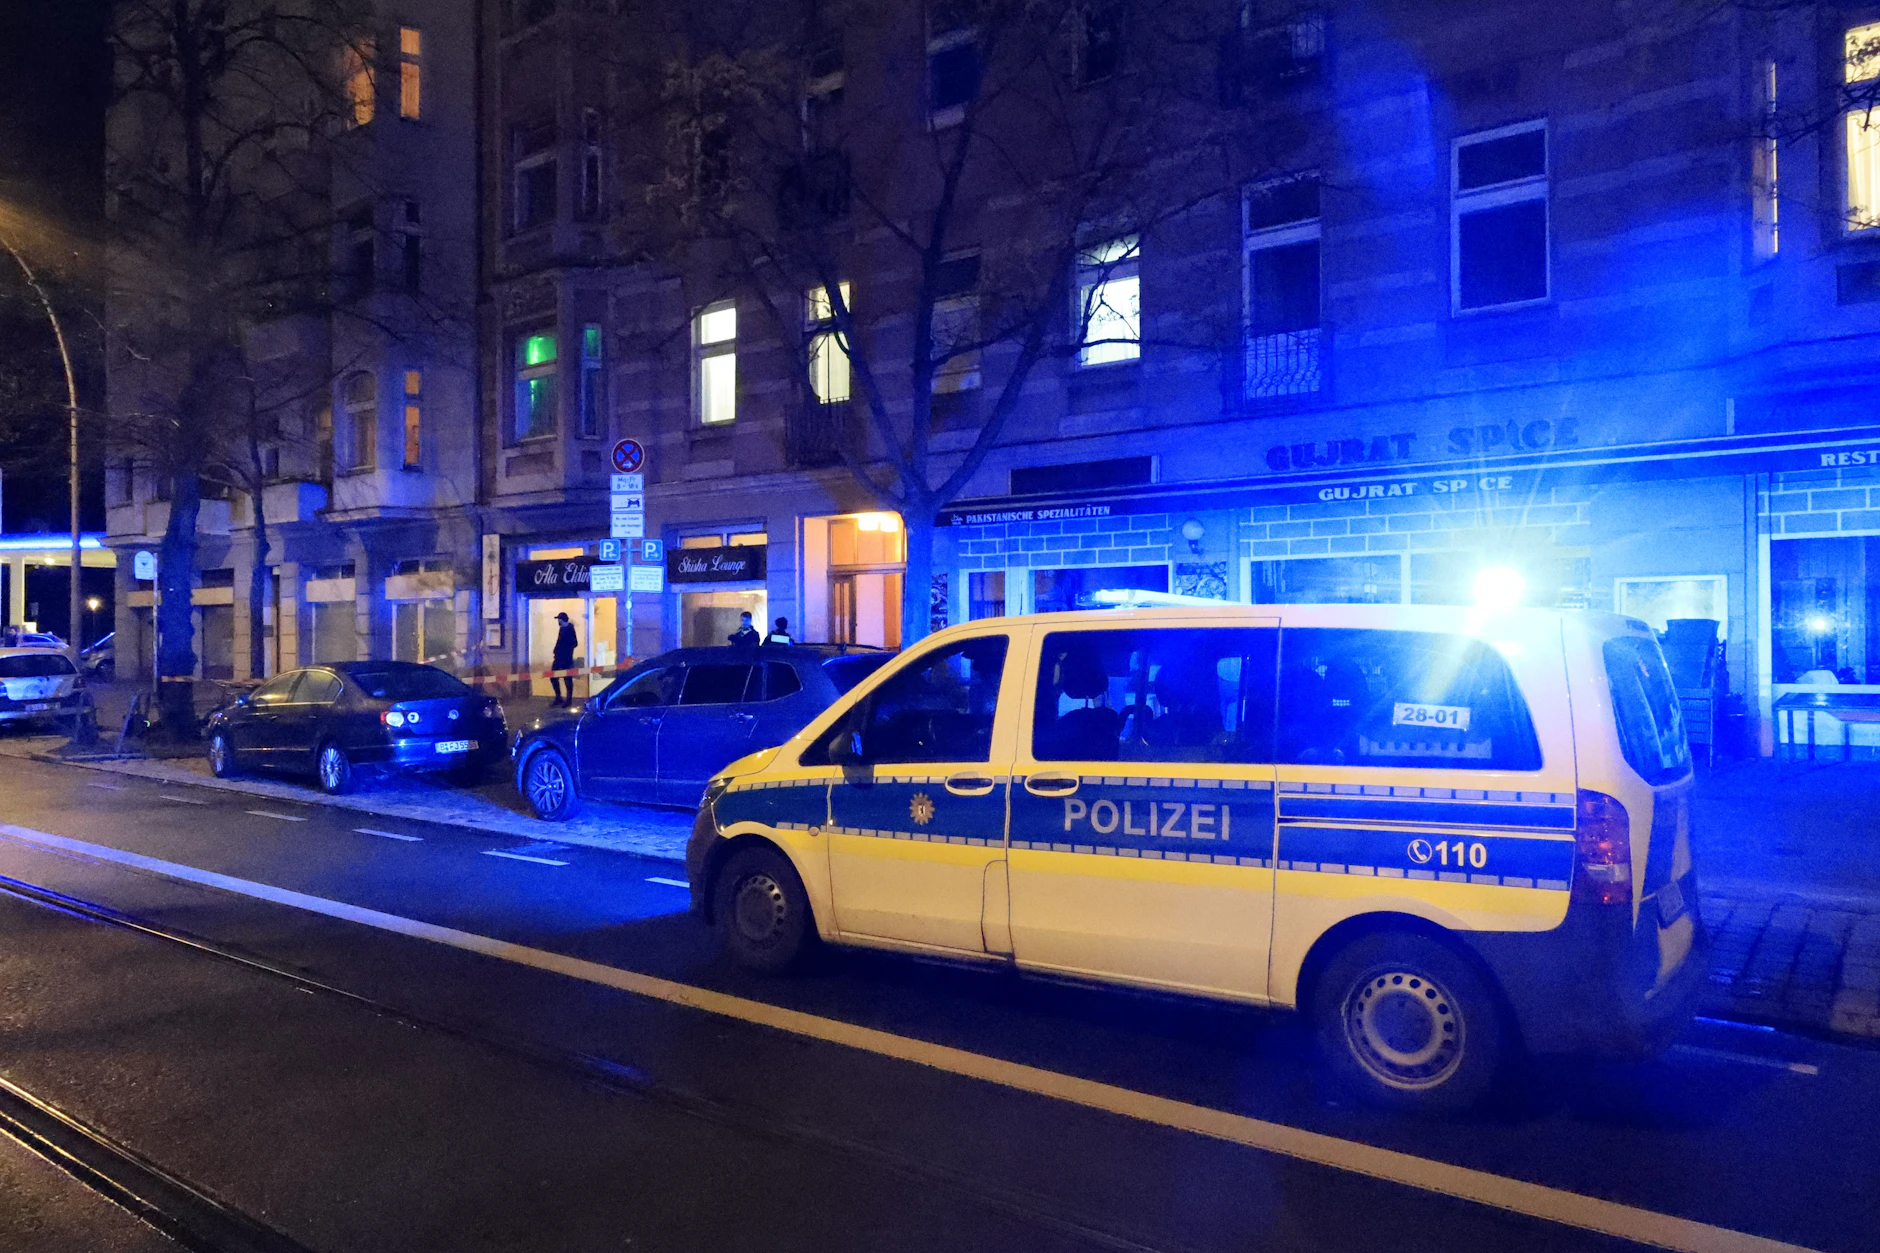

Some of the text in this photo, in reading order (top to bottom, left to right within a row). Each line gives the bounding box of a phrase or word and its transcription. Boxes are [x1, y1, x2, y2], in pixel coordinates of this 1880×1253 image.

[1266, 418, 1580, 470] GUJRAT SPICE
[1318, 483, 1418, 501] GUJRAT
[965, 504, 1111, 525] PAKISTANISCHE SPEZIALITÄTEN
[603, 542, 613, 558] P
[645, 542, 656, 558] P
[678, 553, 746, 575] Shisha Lounge
[1402, 707, 1459, 725] 28-01
[1064, 798, 1230, 841] POLIZEI
[1435, 840, 1487, 868] 110
